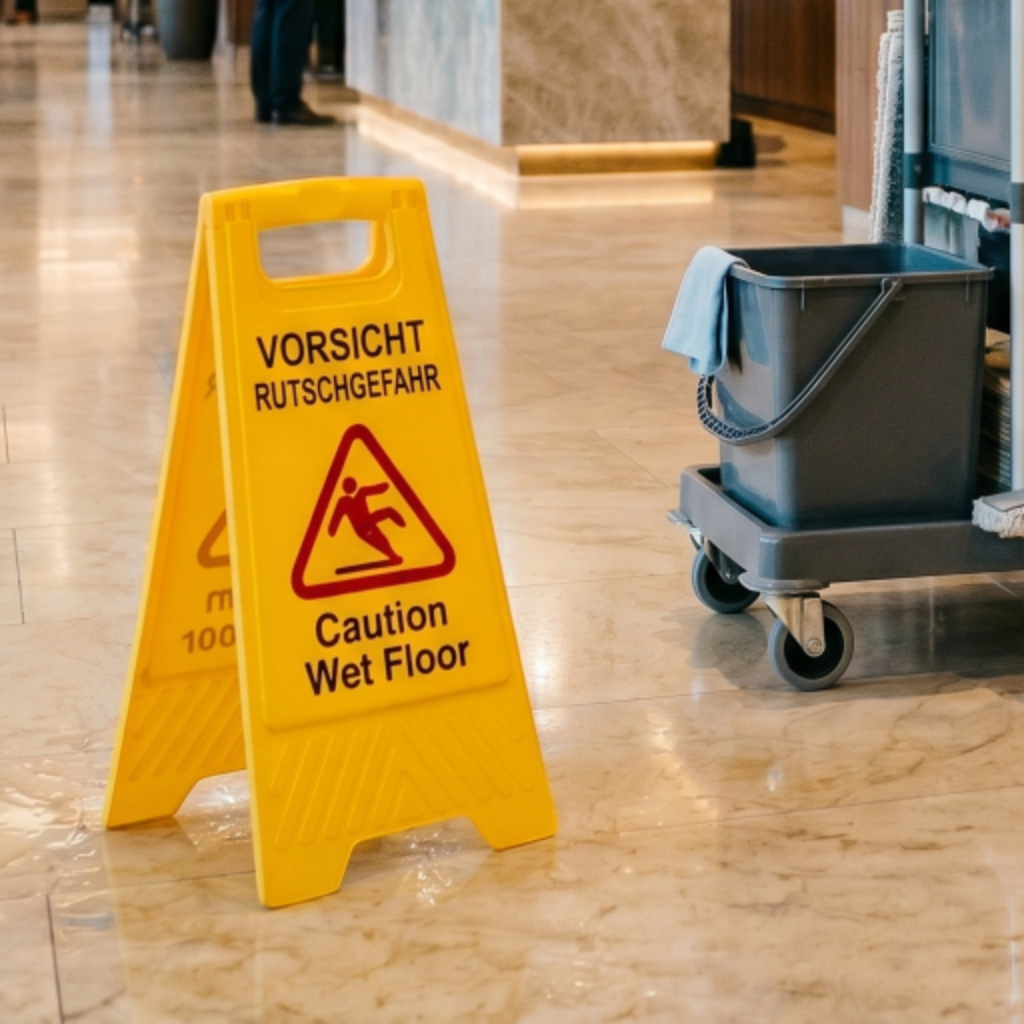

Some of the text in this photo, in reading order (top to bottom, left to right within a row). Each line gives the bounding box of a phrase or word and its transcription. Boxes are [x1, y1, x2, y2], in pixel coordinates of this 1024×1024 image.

[256, 319, 424, 369] VORSICHT
[254, 363, 441, 411] RUTSCHGEFAHR
[315, 601, 448, 648] Caution
[304, 640, 470, 696] Wet Floor
